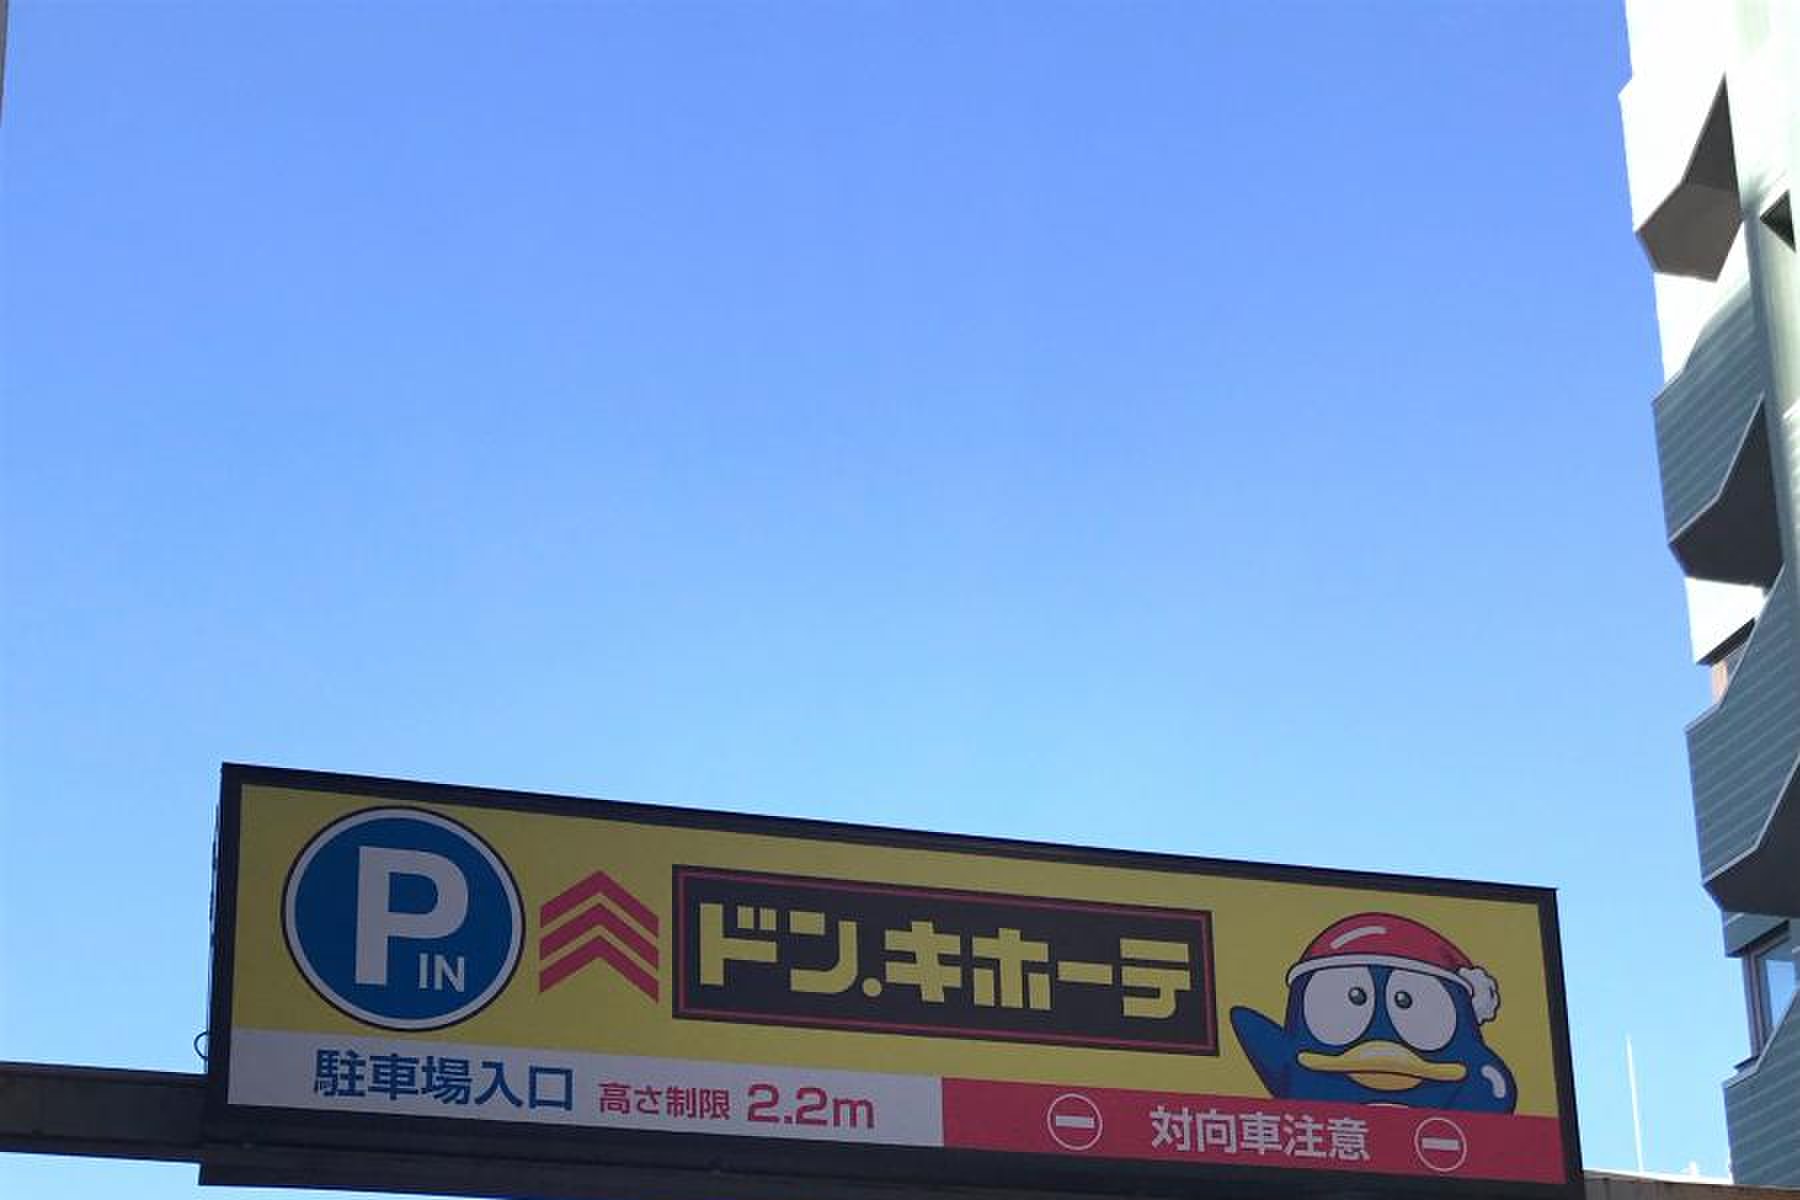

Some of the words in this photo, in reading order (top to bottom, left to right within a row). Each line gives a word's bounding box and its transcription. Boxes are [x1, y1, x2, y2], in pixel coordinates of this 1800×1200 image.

[353, 845, 470, 986] P
[418, 952, 466, 993] IN
[313, 1047, 573, 1112] 駐車場入口
[599, 1081, 730, 1122] 高さ制限
[746, 1083, 875, 1130] 2.2m
[1149, 1104, 1371, 1162] 対向車注意
